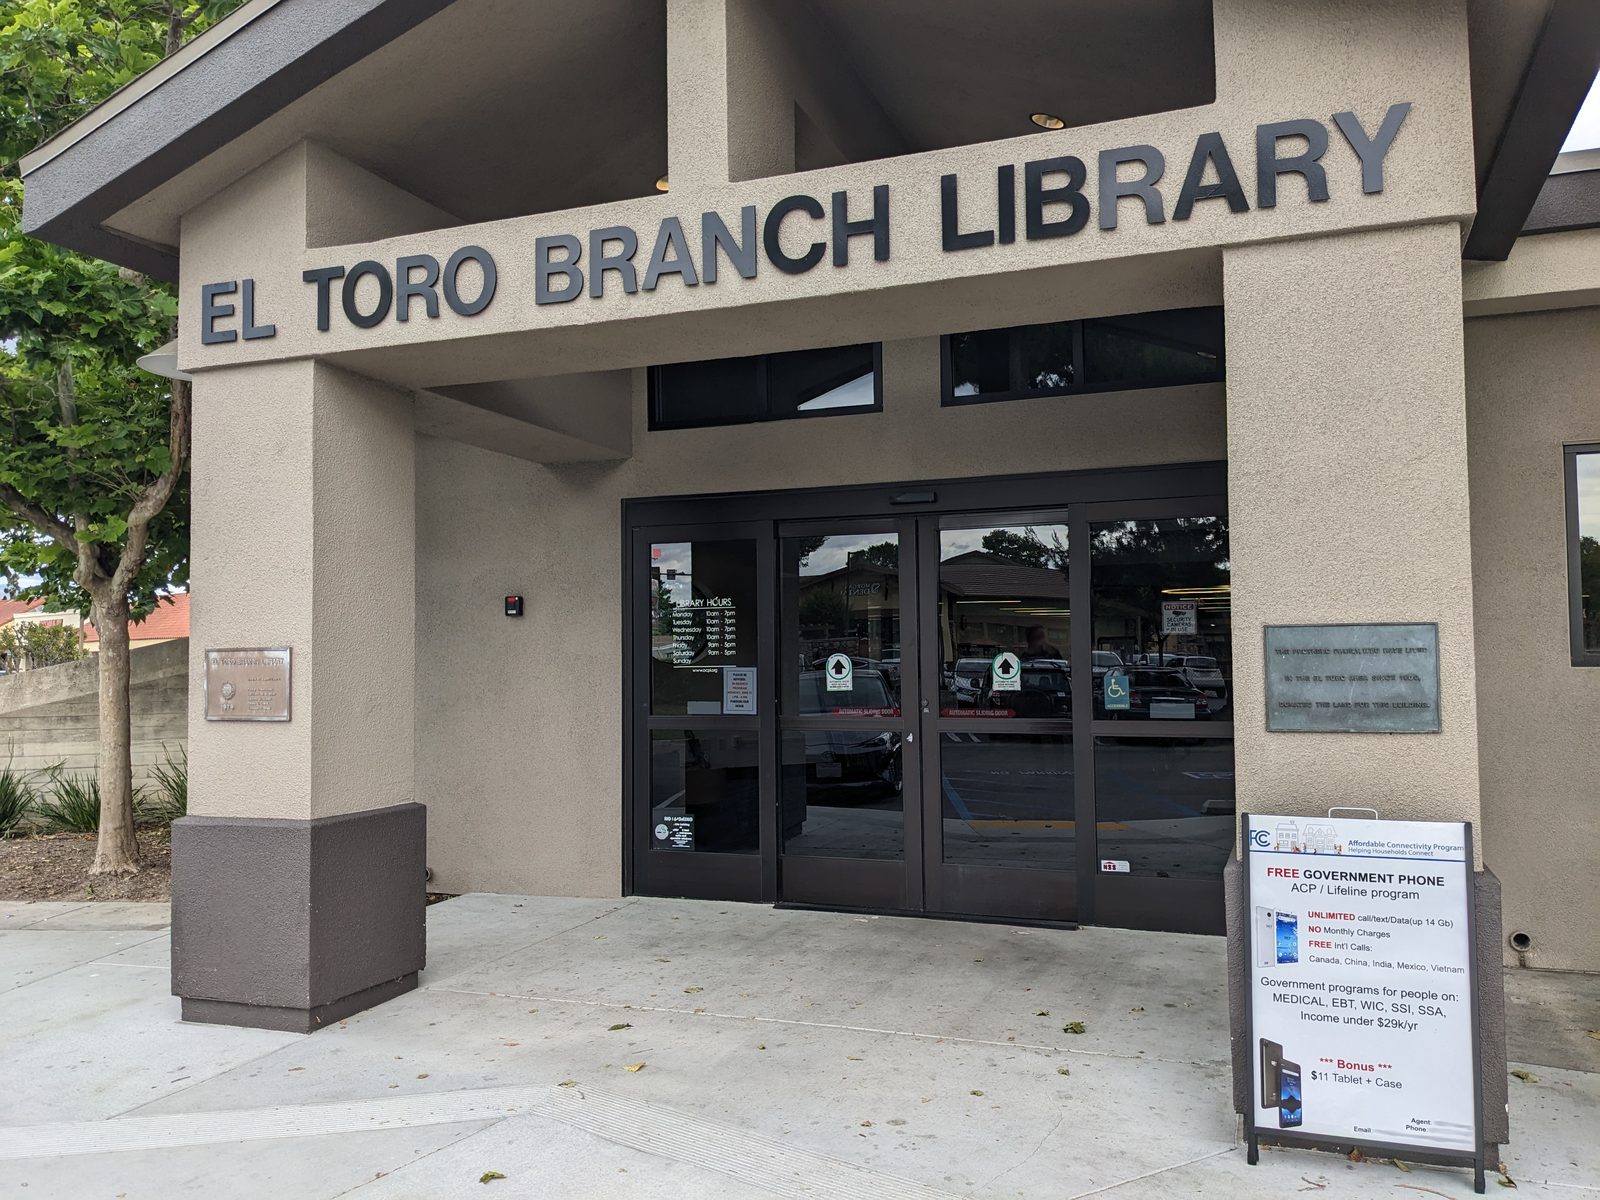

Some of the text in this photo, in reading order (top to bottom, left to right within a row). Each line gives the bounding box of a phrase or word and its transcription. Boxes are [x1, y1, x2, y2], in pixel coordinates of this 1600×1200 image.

[201, 102, 1412, 344] EL TORO BRANCH LIBRARY
[676, 596, 732, 608] LIBRARY HOURS
[1348, 847, 1371, 855] Helping
[1372, 848, 1407, 856] Households
[1386, 841, 1432, 851] Connectivity
[1433, 844, 1464, 852] Program
[1267, 867, 1445, 886] FREE GOVERNMENT PHONE
[1291, 883, 1420, 901] ACP / Lifeline program
[1308, 911, 1454, 928] UNLIMITED call/text/Data(up 14 Gb)
[1323, 926, 1354, 937] Monthly
[1356, 929, 1391, 939] Charges
[1308, 940, 1332, 949] FREE
[1350, 943, 1373, 952] Calls:
[1308, 955, 1465, 974] Canada, China, India, Mexico, Vietnam
[1260, 976, 1459, 1003] Government programs for people on:
[1272, 992, 1446, 1018] MEDICAL, EBT, WIC, SSI, SSA,
[1300, 1011, 1419, 1031] Income under $29k/yr
[1337, 1060, 1375, 1072] Bonus
[1311, 1070, 1329, 1081] $11
[1332, 1073, 1363, 1085] Tablet
[1375, 1077, 1403, 1089] Case
